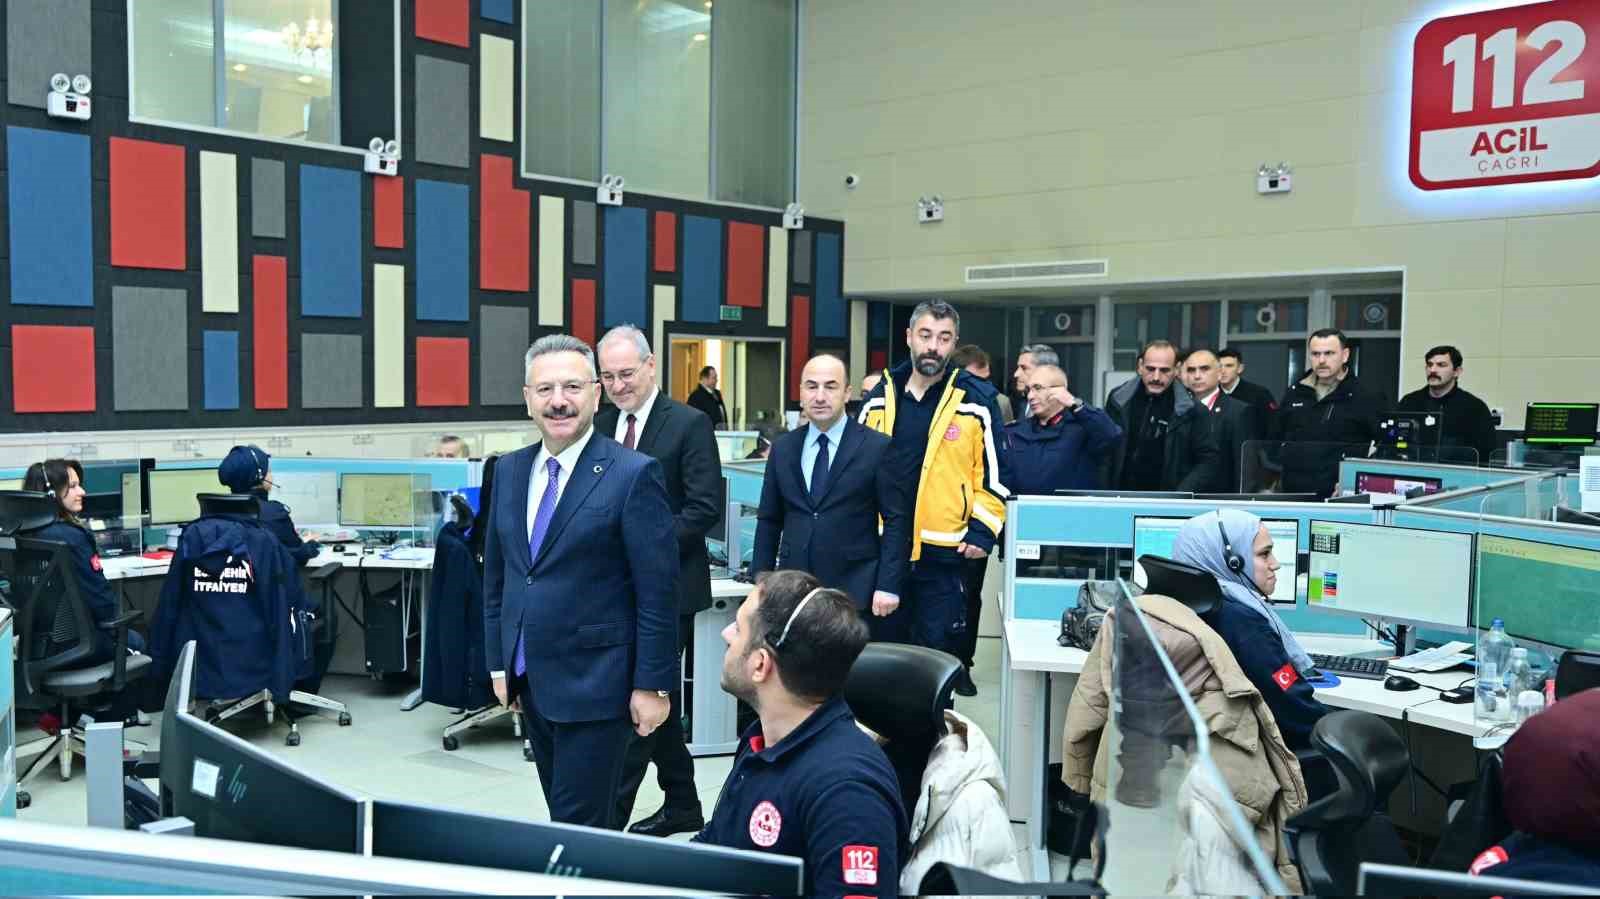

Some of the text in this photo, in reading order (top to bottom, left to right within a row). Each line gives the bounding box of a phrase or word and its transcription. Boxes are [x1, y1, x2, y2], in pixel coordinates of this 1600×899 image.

[1442, 20, 1586, 113] 112
[1477, 155, 1539, 174] ÇAĞRI
[848, 850, 874, 869] 112
